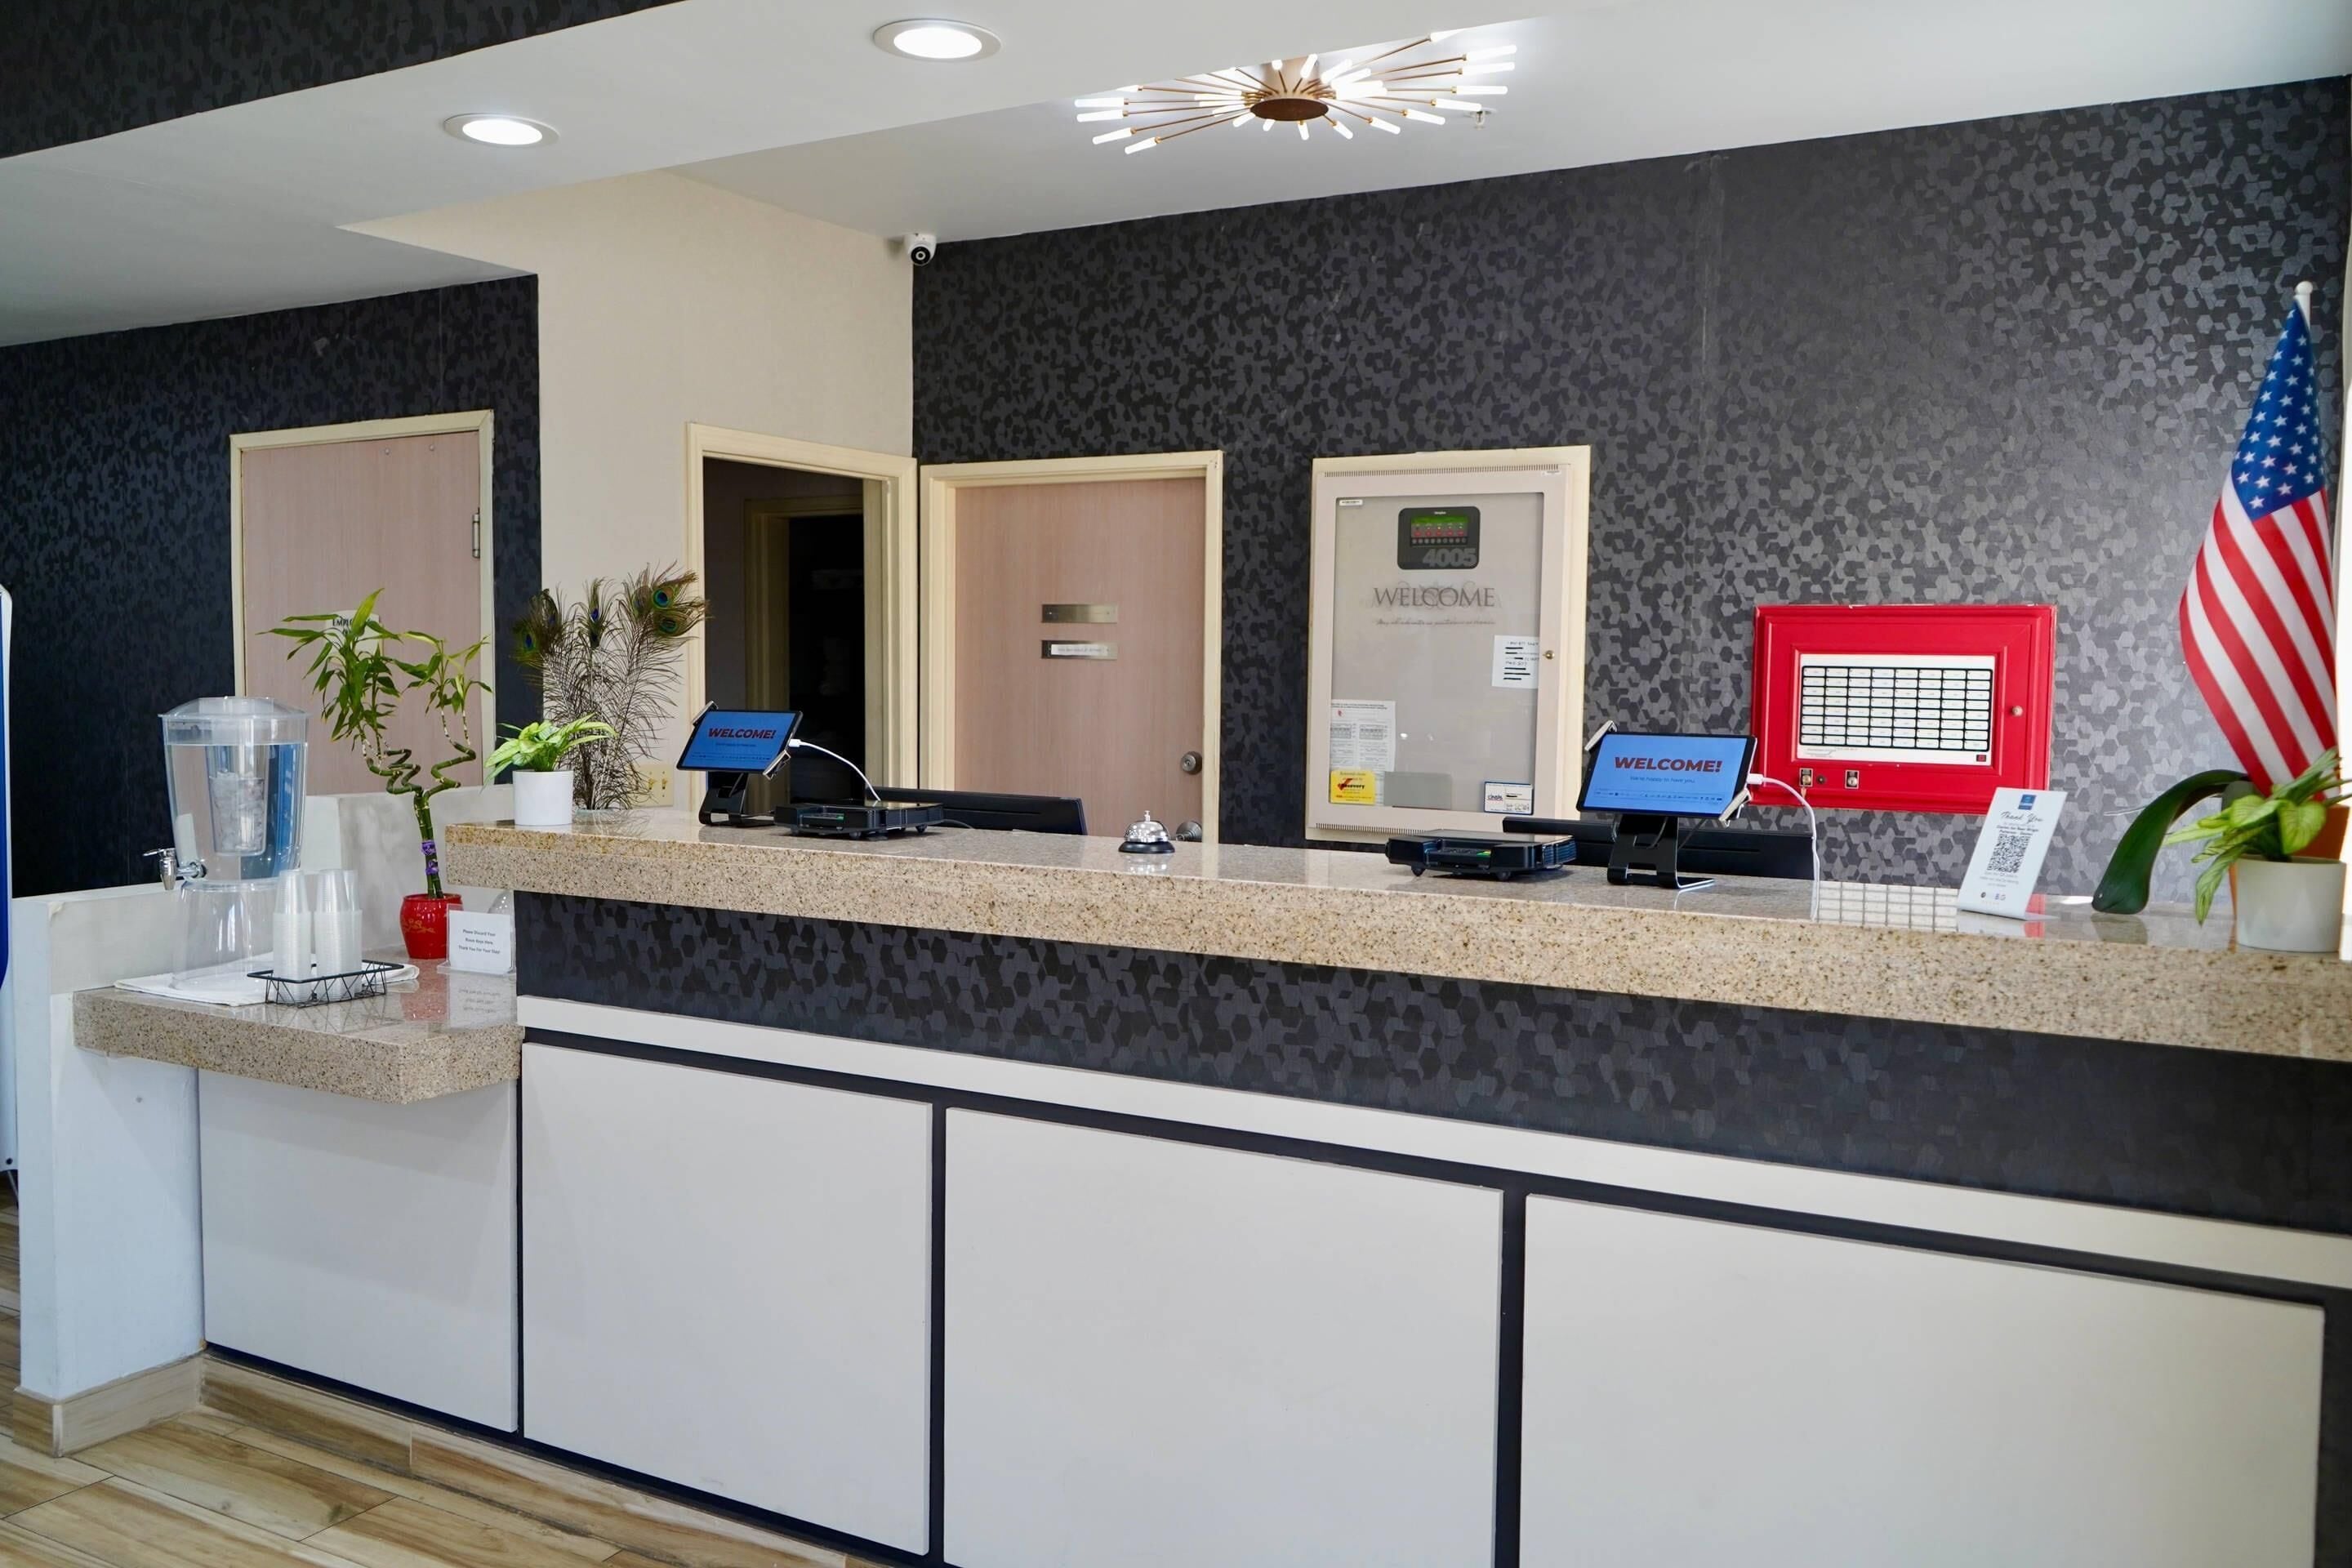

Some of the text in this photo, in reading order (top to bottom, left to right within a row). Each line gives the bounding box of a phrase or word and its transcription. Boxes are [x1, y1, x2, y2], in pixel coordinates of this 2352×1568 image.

[1422, 549, 1477, 568] 4005
[1373, 587, 1495, 607] WELCOME
[708, 728, 777, 739] WELCOME!
[1614, 756, 1723, 773] WELCOME!
